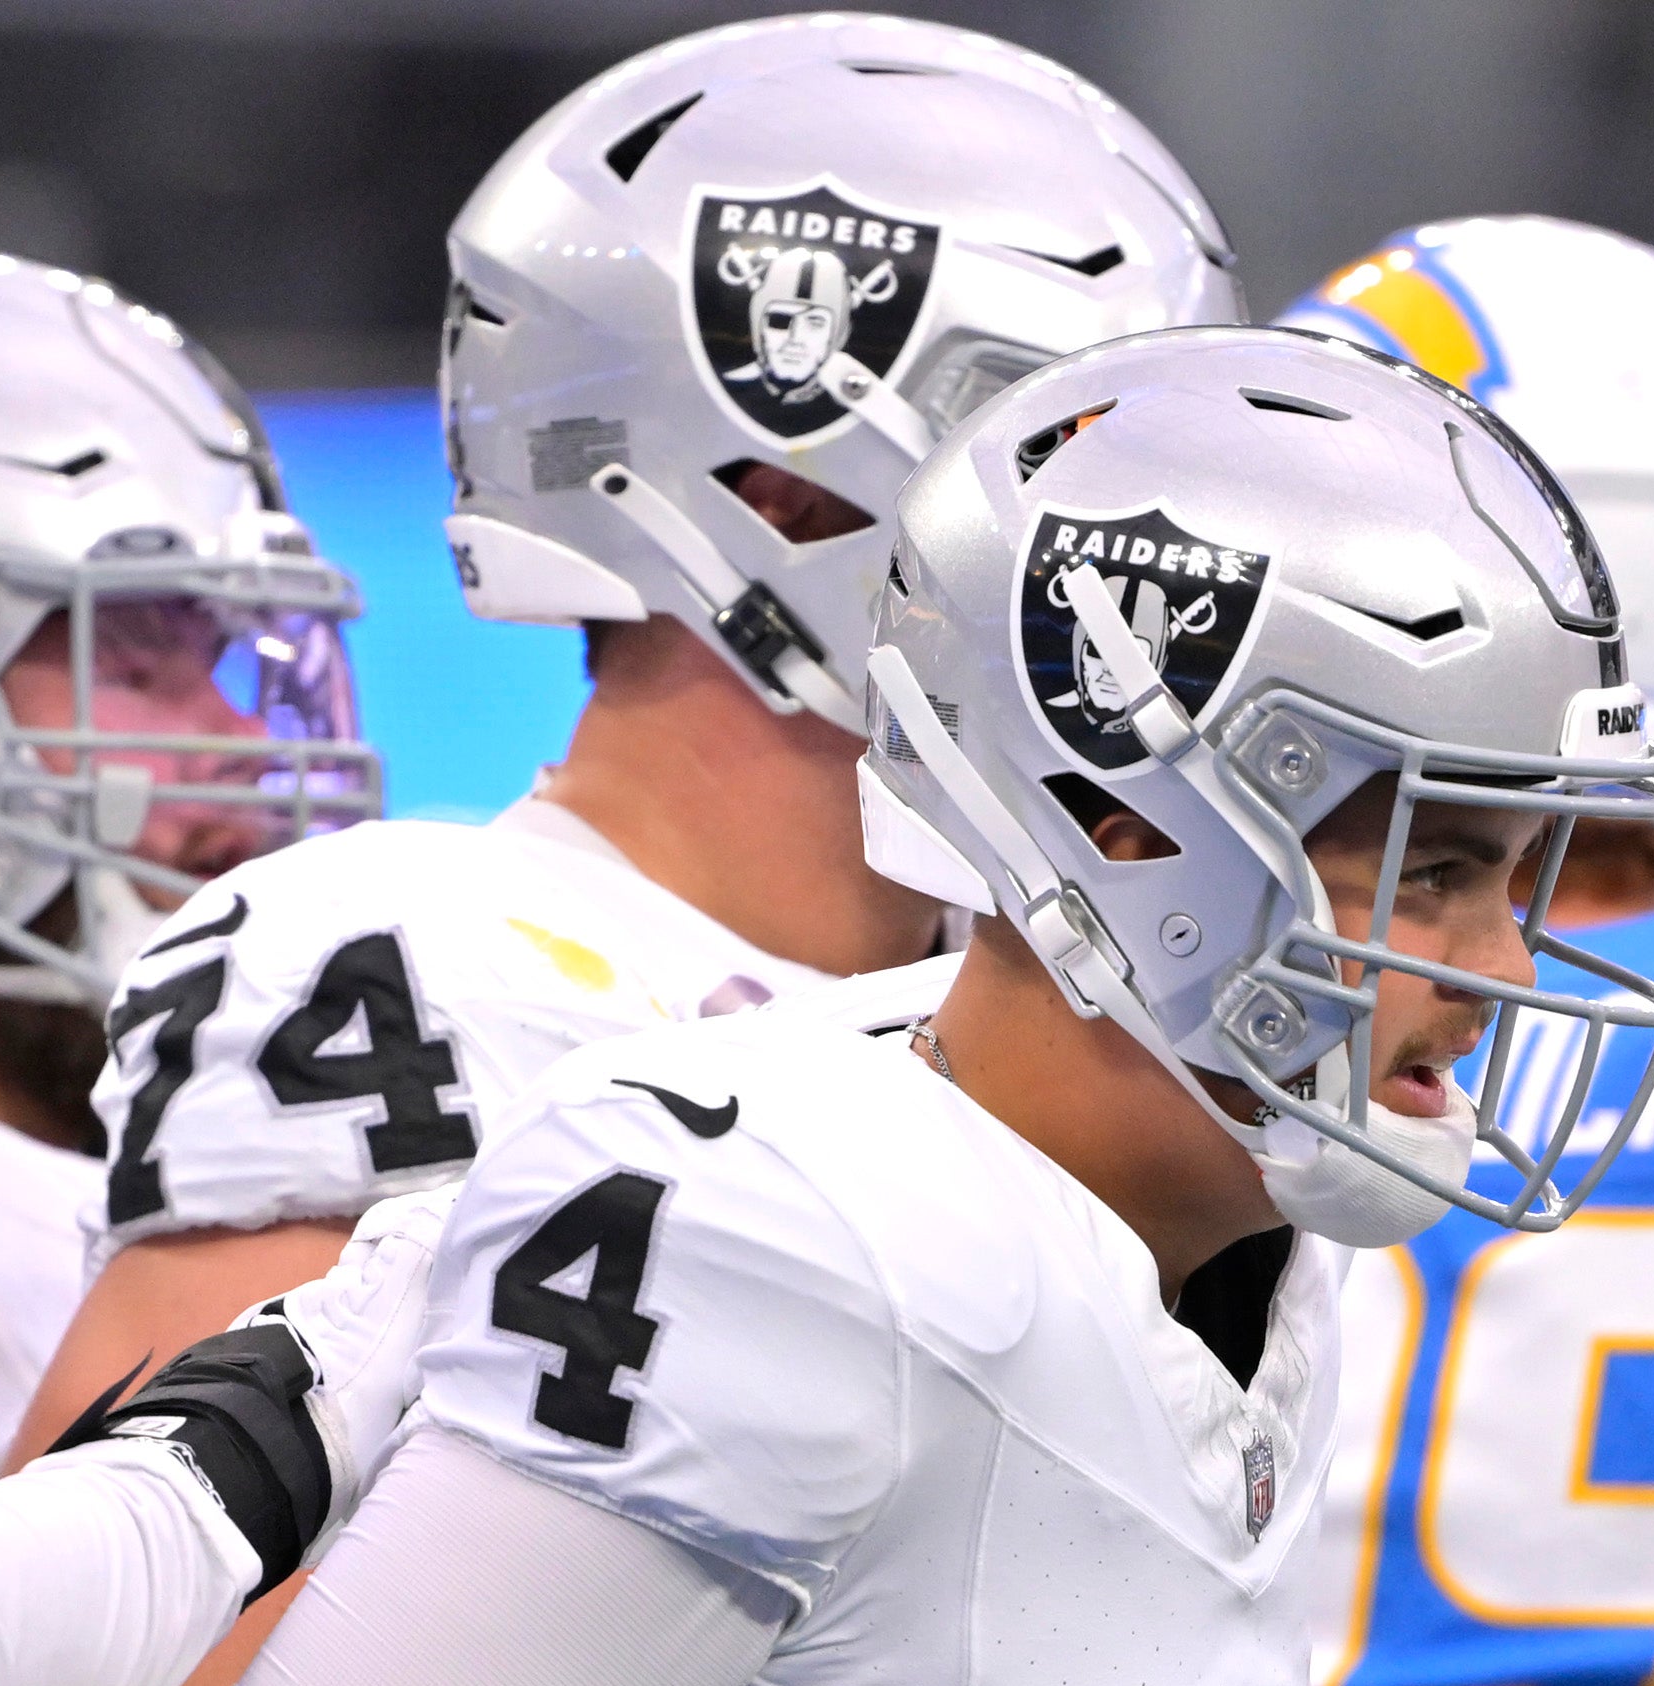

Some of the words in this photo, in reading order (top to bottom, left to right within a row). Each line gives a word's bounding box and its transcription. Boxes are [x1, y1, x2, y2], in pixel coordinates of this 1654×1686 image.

[718, 203, 919, 253] RAIDERS
[1053, 523, 1245, 585] RAIDERS
[1597, 702, 1645, 736] RAIDE
[108, 930, 479, 1226] 74
[489, 1170, 669, 1451] 4
